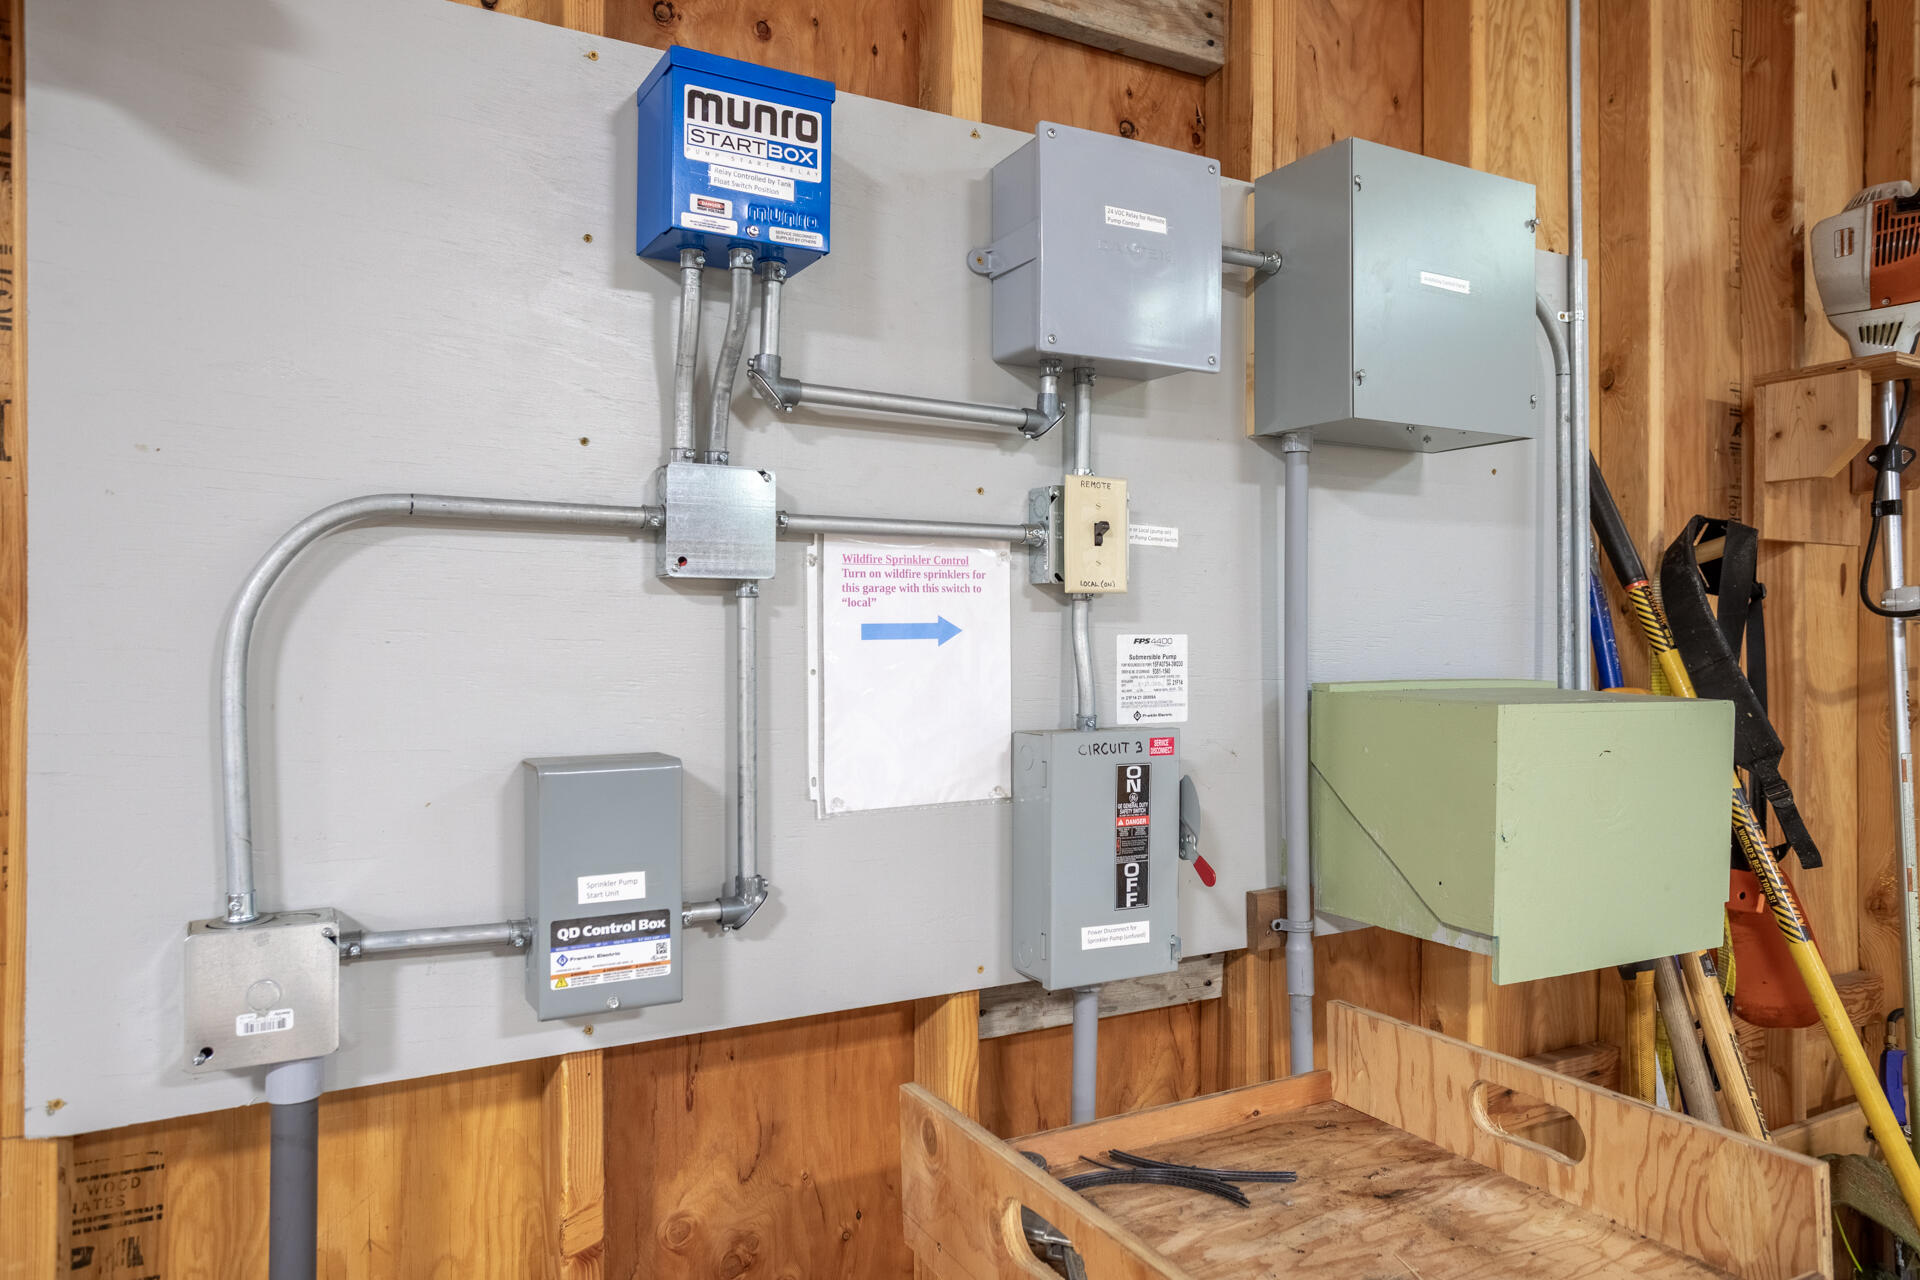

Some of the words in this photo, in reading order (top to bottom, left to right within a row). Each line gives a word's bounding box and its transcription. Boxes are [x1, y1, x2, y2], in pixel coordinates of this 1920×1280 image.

[687, 89, 818, 143] munro
[687, 147, 720, 157] PUMP
[731, 156, 769, 168] START
[781, 164, 818, 177] RELAY
[714, 167, 732, 177] Relay
[733, 169, 766, 184] Controlled
[768, 175, 775, 185] by
[777, 179, 792, 188] Tank
[714, 177, 731, 186] Float
[732, 180, 752, 190] Switch
[754, 185, 779, 196] Position
[1107, 217, 1121, 225] Pump
[1122, 219, 1140, 227] Control
[1080, 480, 1111, 490] REMOTE
[842, 553, 882, 564] Wildfire
[885, 554, 931, 566] Sprinkler
[933, 555, 969, 565] Control
[842, 568, 866, 578] Turn
[885, 568, 921, 579] wildfire
[924, 569, 970, 581] sprinklers
[972, 569, 986, 579] for
[841, 583, 860, 593] this
[862, 585, 896, 595] garage
[899, 583, 919, 593] with
[922, 583, 939, 593] this
[941, 583, 970, 593] switch
[973, 585, 982, 593] to
[1080, 580, 1099, 588] LOCAL
[841, 597, 877, 607] “local”
[1078, 742, 1130, 756] CIRCUIT
[1135, 741, 1143, 753] 3
[1150, 746, 1173, 754] DISCONNECT
[1126, 766, 1142, 793] ON
[1738, 828, 1756, 863] WORLD'S
[1752, 859, 1765, 879] BEST
[1760, 876, 1778, 906] TOOLS!
[586, 879, 617, 889] Sprinkler
[618, 878, 638, 886] Pump
[1124, 863, 1140, 907] OFF
[557, 927, 580, 941] QD
[582, 920, 636, 937] Control
[638, 918, 666, 931] Box
[1103, 925, 1129, 934] Disconnect
[1088, 936, 1108, 944] Sprinkler
[596, 951, 621, 959] Electric
